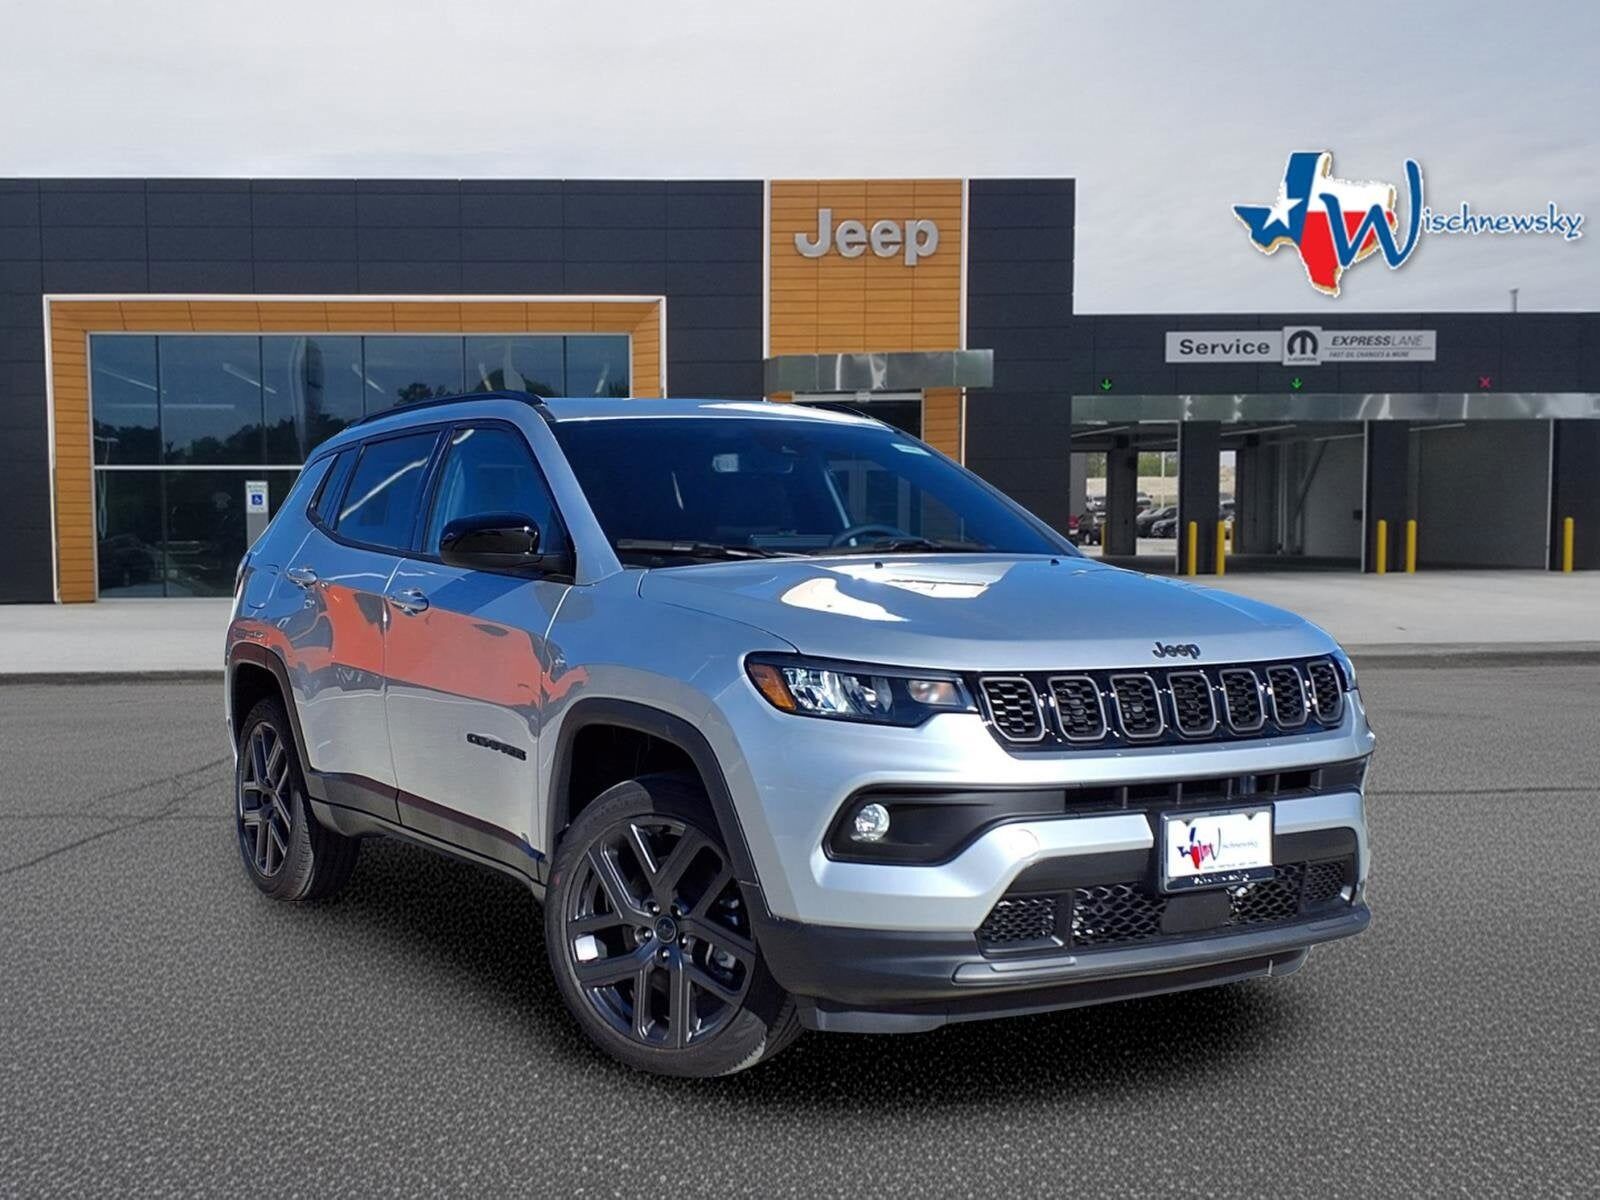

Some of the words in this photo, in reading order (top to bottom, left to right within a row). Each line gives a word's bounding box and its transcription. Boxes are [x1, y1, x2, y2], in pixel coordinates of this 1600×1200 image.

[794, 208, 939, 266] Jeep
[1179, 338, 1271, 355] Service
[1152, 641, 1201, 659] Jeep
